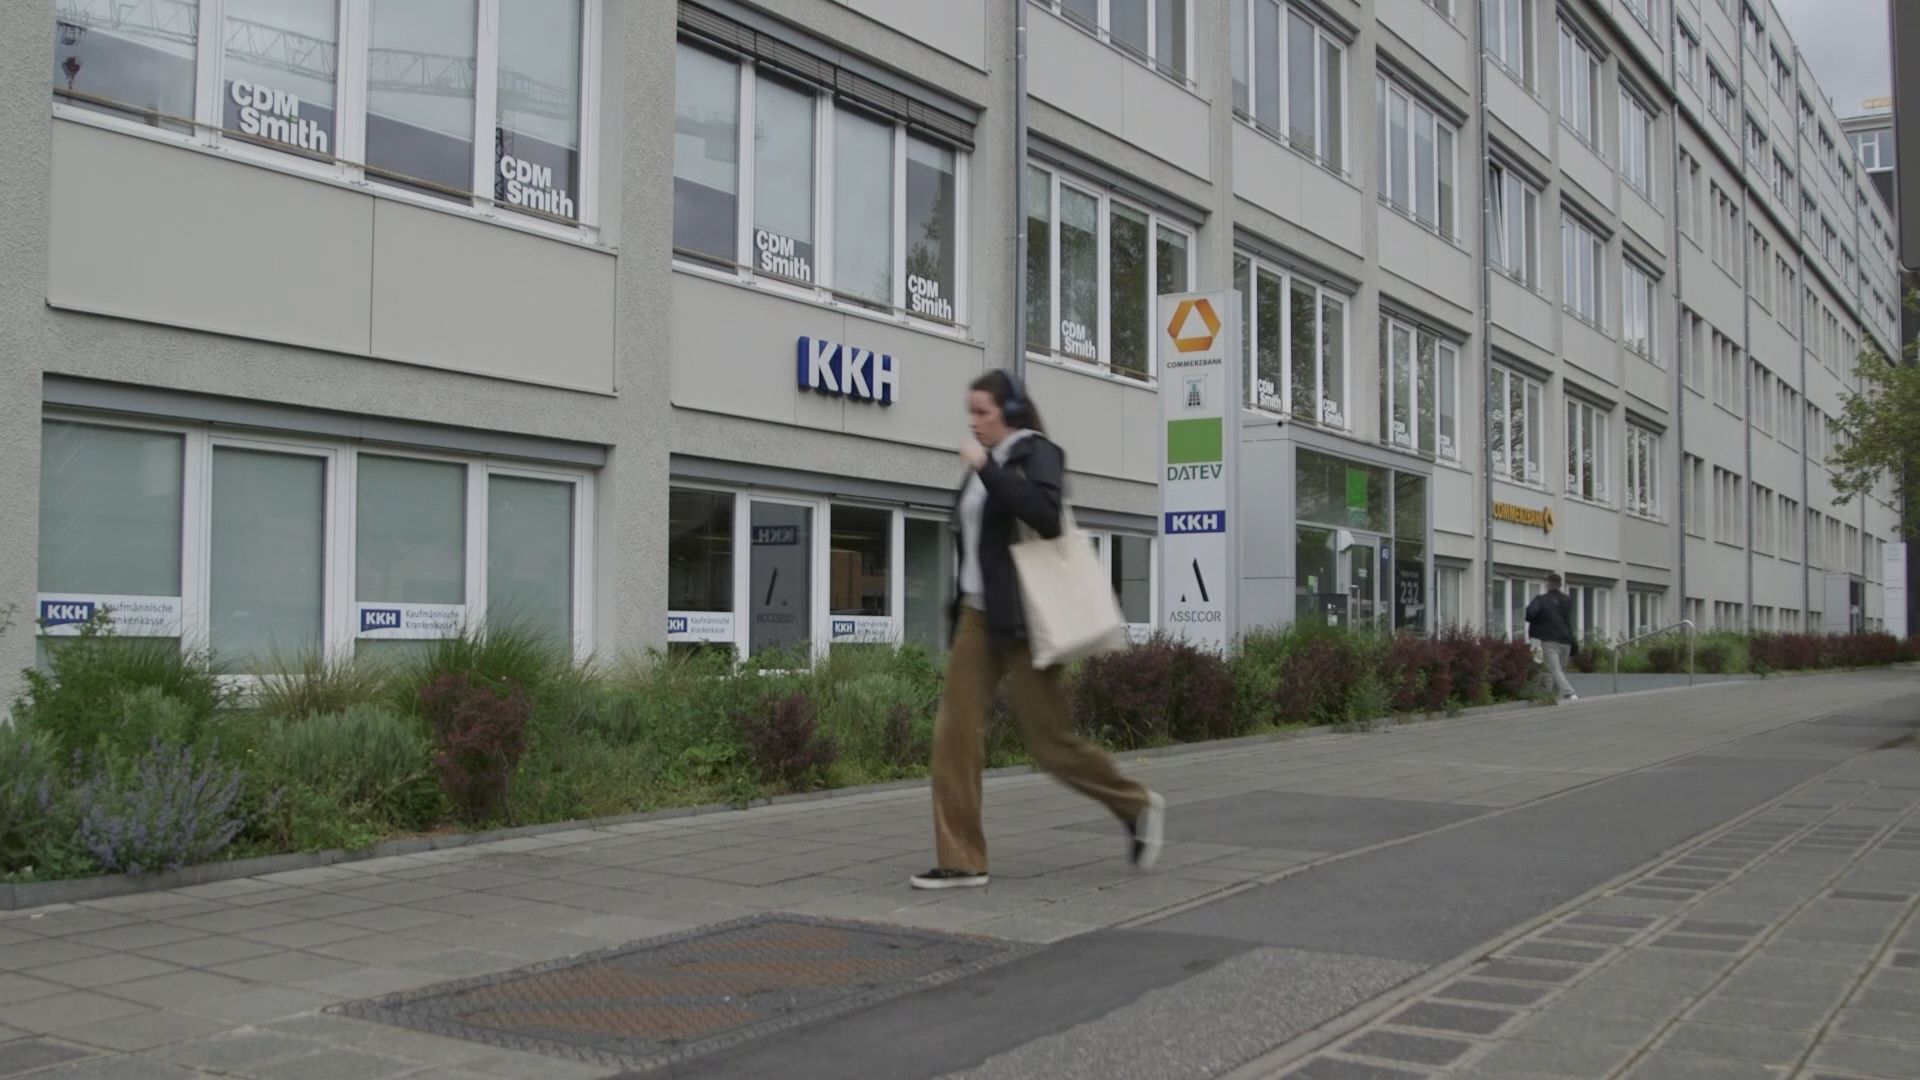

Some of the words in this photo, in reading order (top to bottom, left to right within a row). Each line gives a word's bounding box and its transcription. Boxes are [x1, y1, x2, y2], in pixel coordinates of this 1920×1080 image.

[232, 80, 299, 117] CDM
[240, 106, 328, 153] Smith
[501, 155, 552, 189] CDM
[507, 179, 574, 218] Smith
[757, 231, 795, 257] CDM
[762, 251, 811, 281] Smith
[908, 275, 939, 297] CDM
[912, 294, 952, 319] Smith
[1062, 320, 1086, 340] CDM
[1065, 336, 1096, 359] Smith
[799, 337, 900, 403] KKH
[1167, 358, 1222, 368] COMMERZBANK
[1258, 378, 1275, 394] CDM
[1260, 391, 1281, 408] Smith
[1167, 464, 1222, 481] DATEV
[1172, 514, 1218, 531] KKH
[1401, 581, 1419, 604] 232
[47, 604, 89, 620] KKH
[366, 612, 396, 625] KKH
[1170, 611, 1222, 622] ASSECOR
[834, 622, 853, 633] KKH
